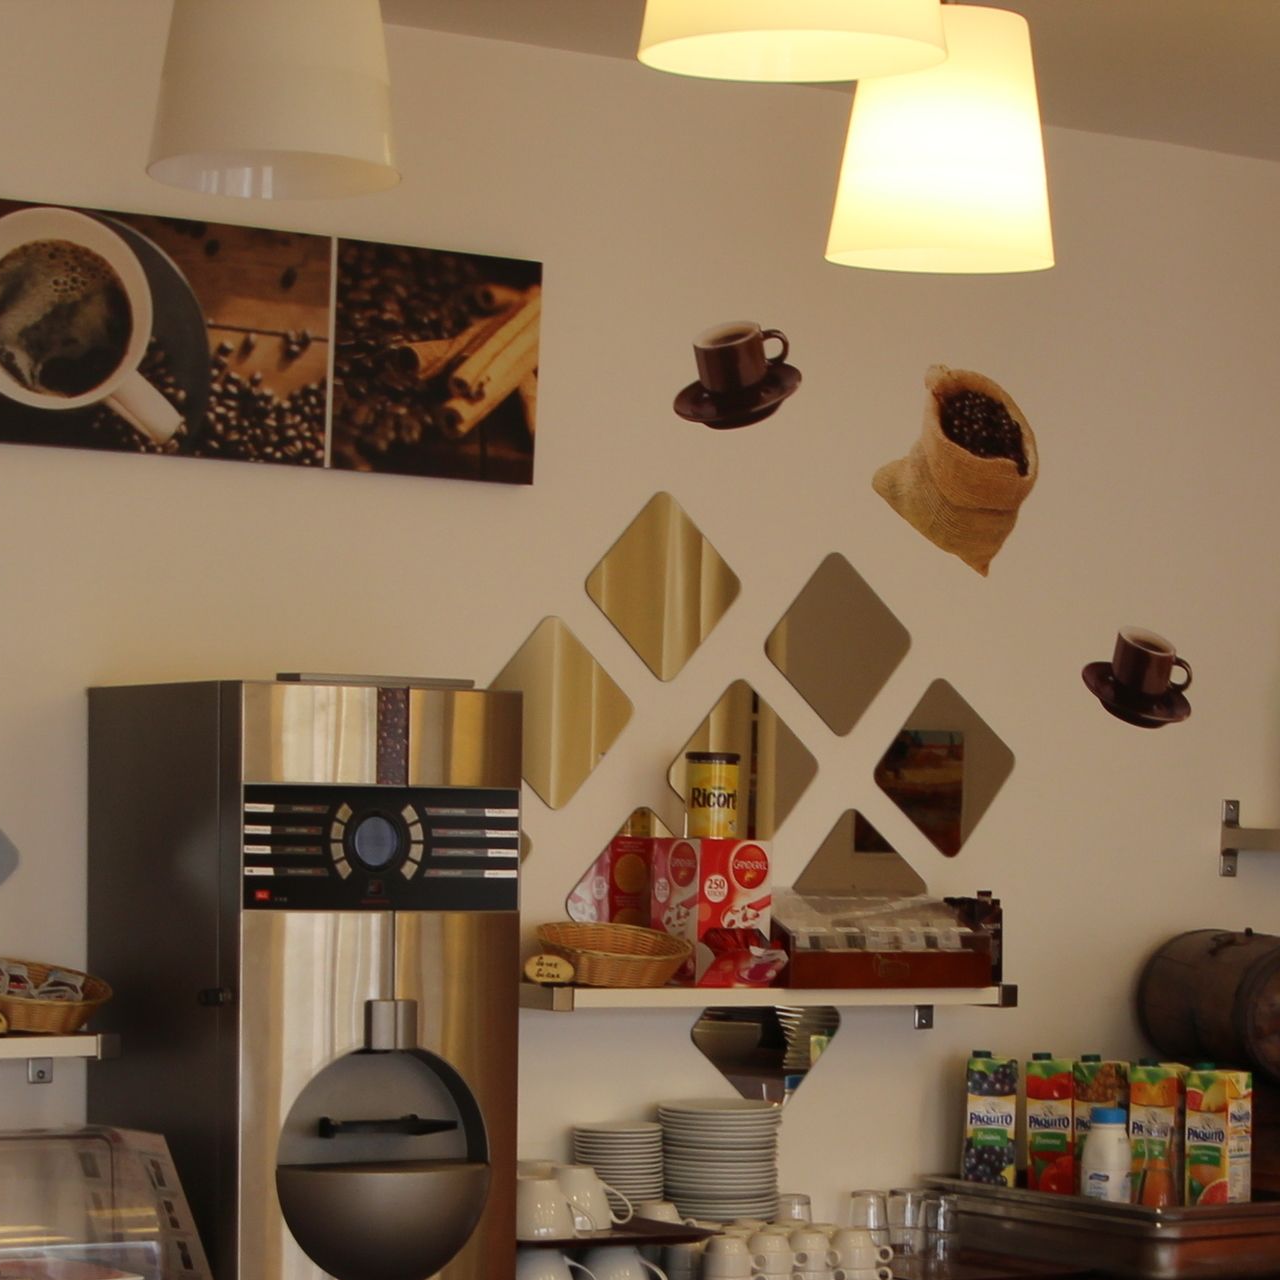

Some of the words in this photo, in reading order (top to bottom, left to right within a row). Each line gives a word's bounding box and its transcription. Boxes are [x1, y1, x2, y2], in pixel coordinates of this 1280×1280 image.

[706, 878, 726, 890] 250
[969, 1111, 1013, 1127] PAQUITO
[1028, 1115, 1070, 1130] PAQUITO
[1187, 1127, 1225, 1143] PAQUITO
